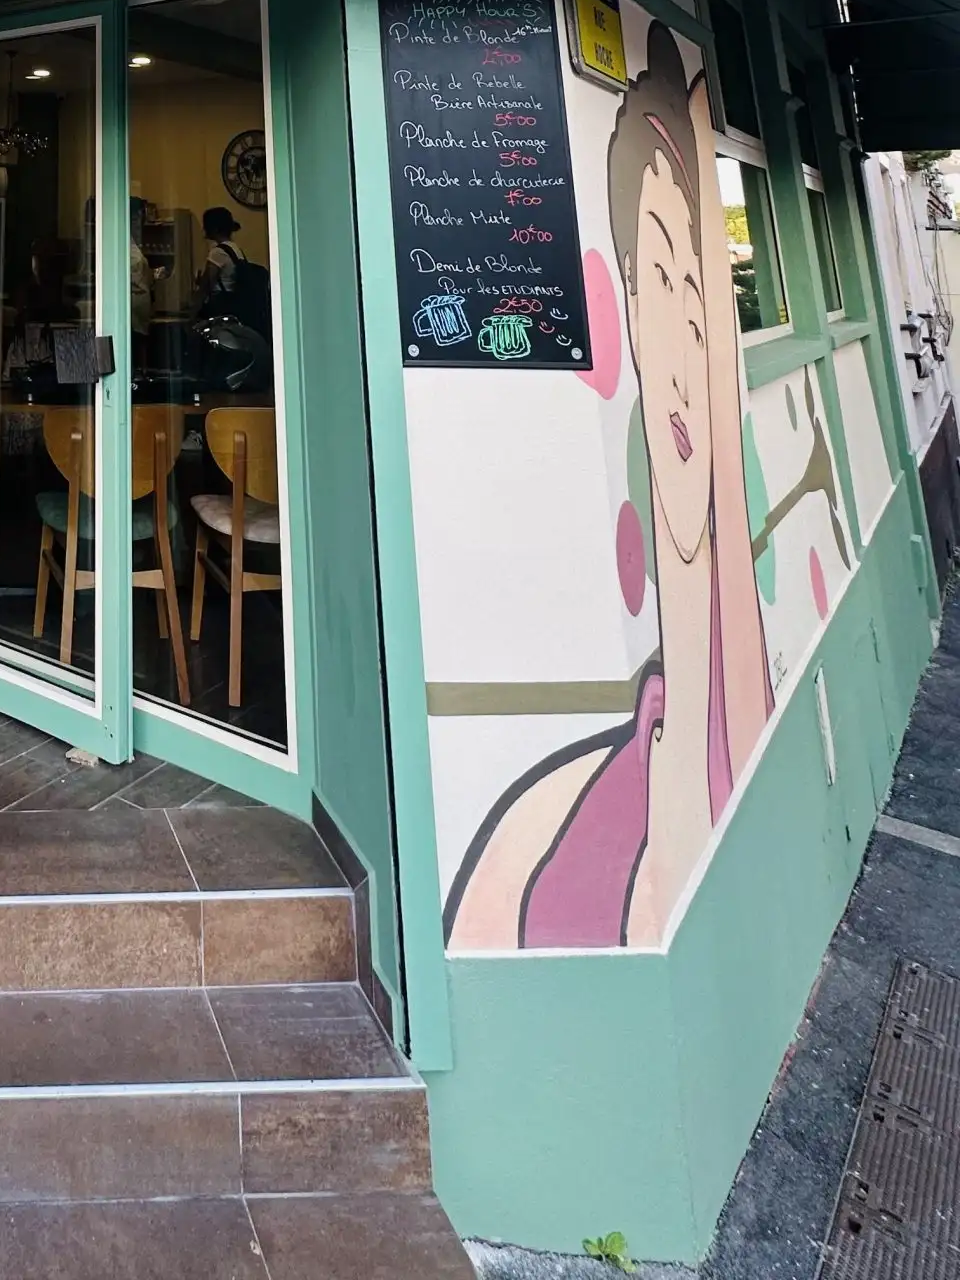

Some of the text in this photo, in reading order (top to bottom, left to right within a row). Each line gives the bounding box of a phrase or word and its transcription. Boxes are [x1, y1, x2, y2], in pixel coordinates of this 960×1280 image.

[389, 22, 436, 44] Pinte
[442, 28, 459, 43] de
[463, 25, 520, 45] Blonde
[394, 70, 526, 92] Pinte de Rebelle
[431, 94, 543, 111] Bière Artisanale
[400, 121, 549, 153] Planche de Fromage
[404, 165, 565, 188] Planche de charcuterie
[410, 201, 513, 226] Planche Mixte
[410, 248, 542, 274] Demi de Blonde
[438, 276, 563, 297] Pour les ETUDIANTS
